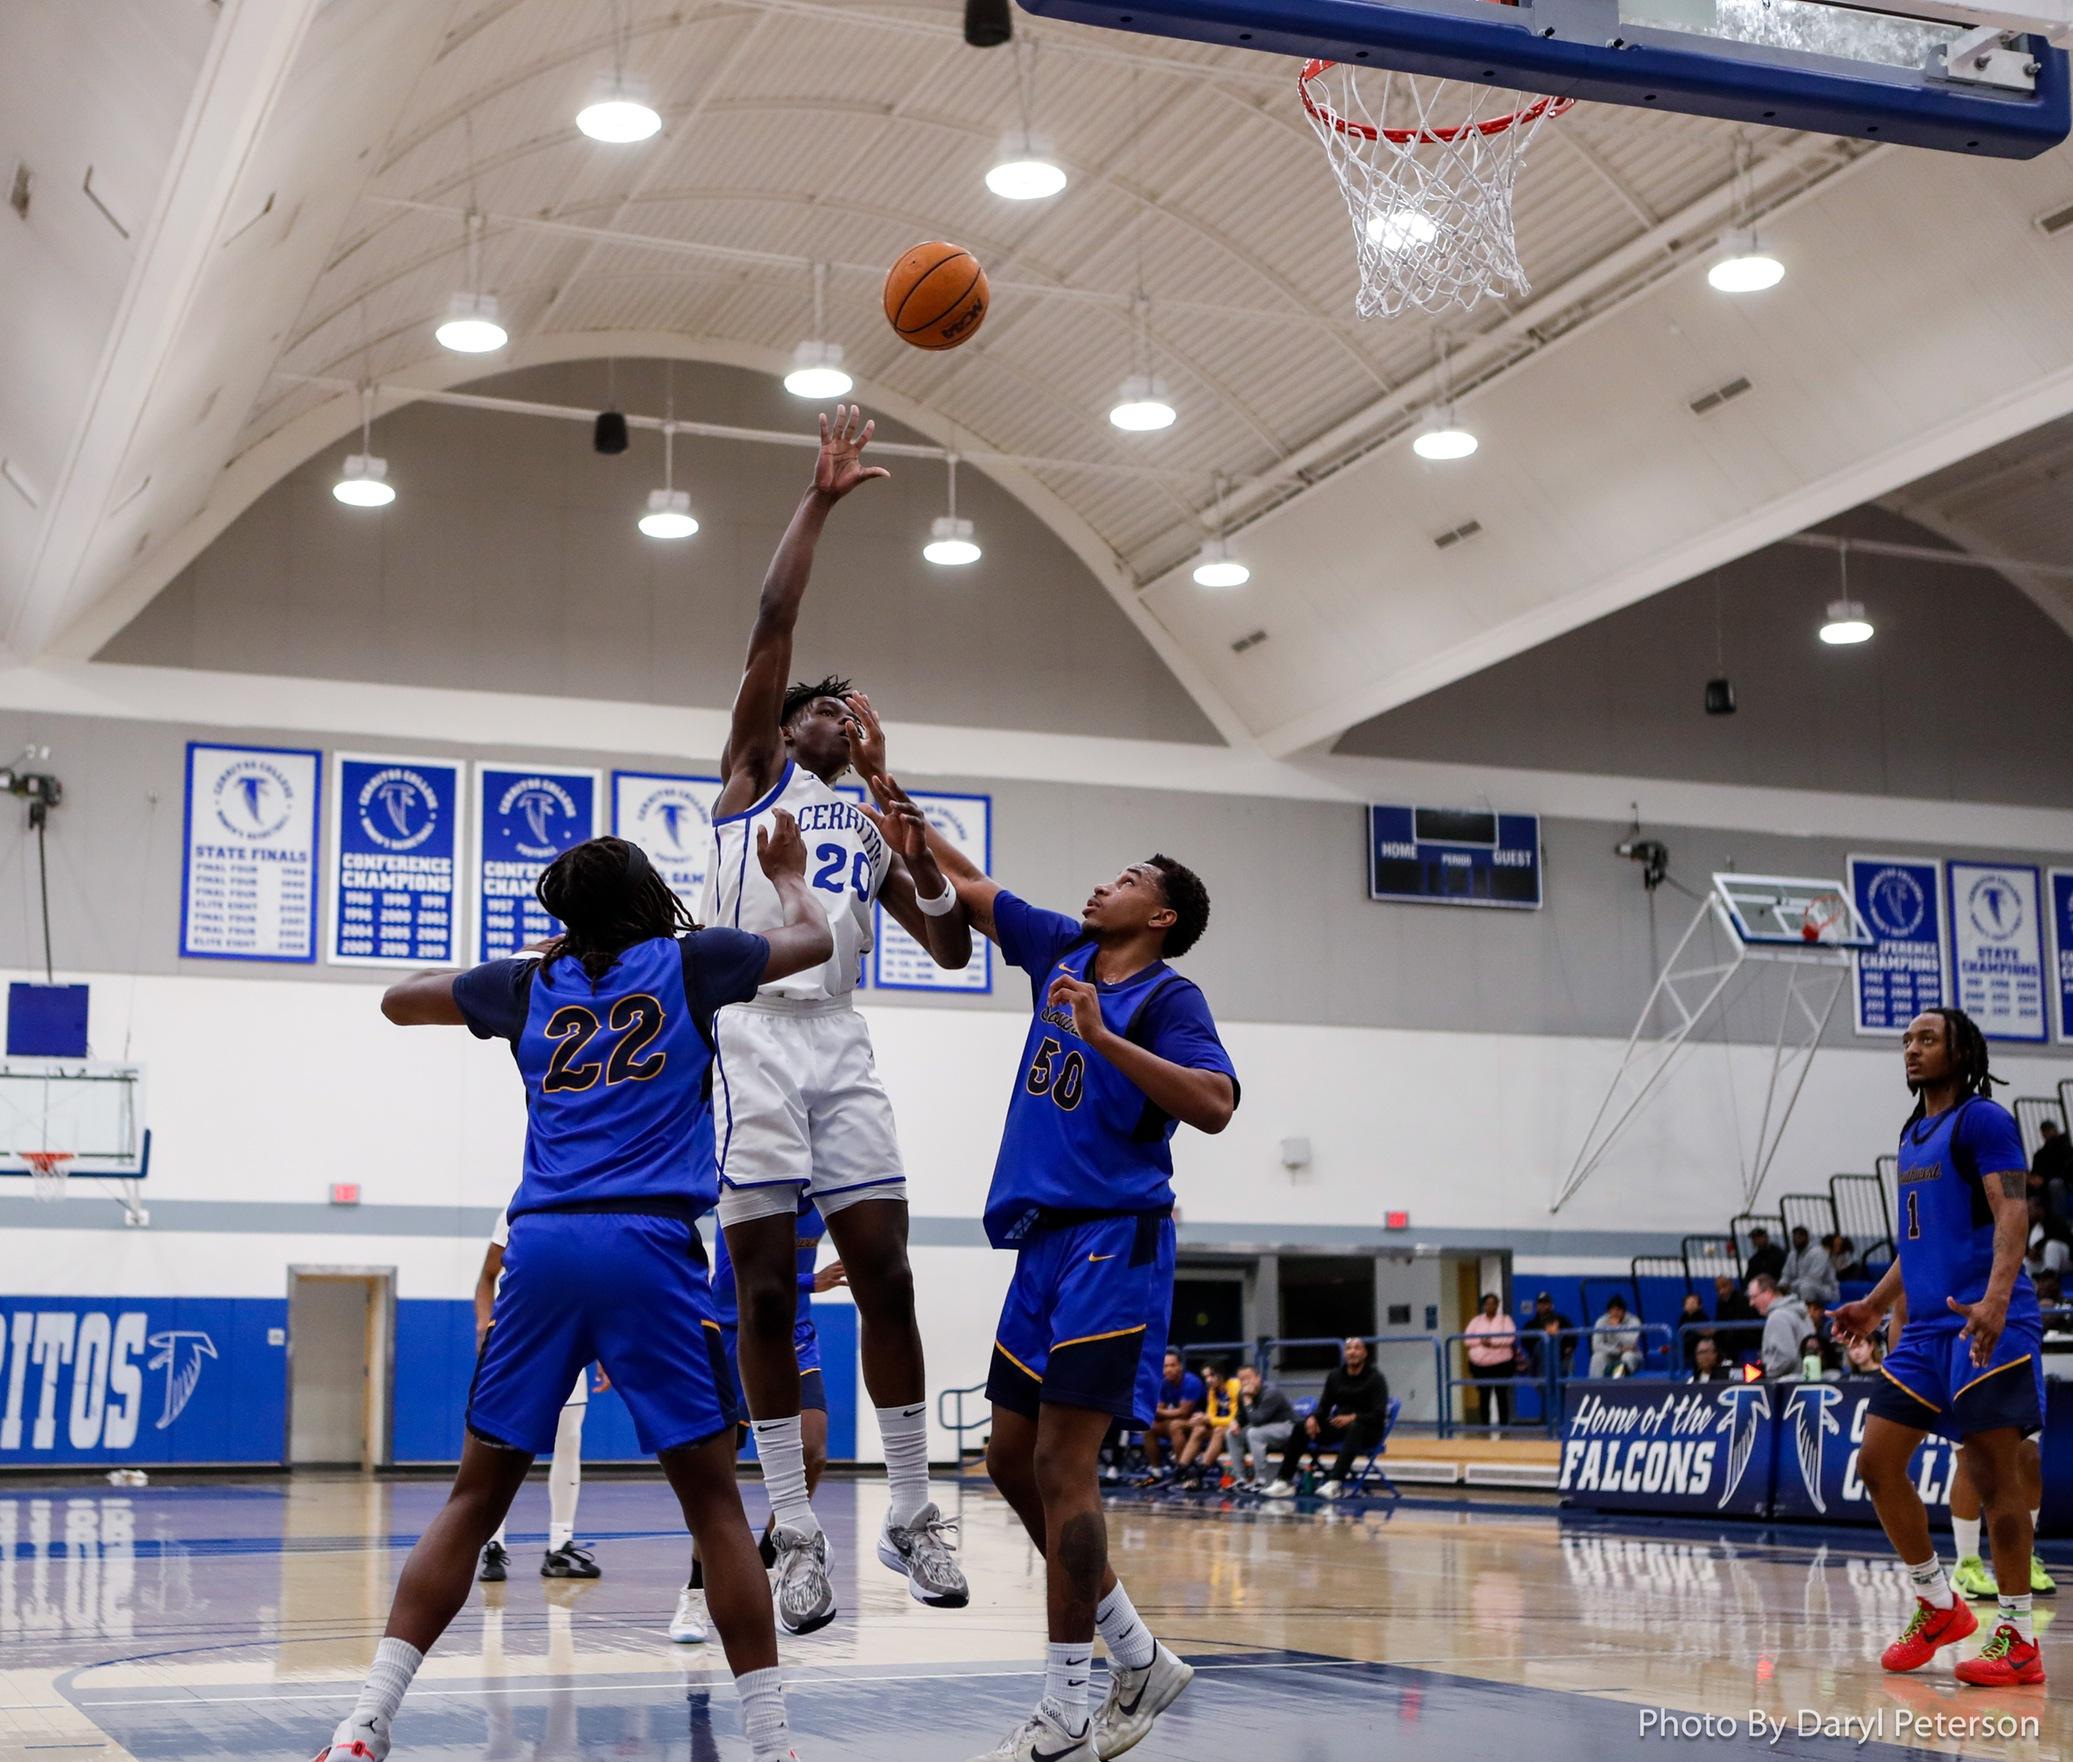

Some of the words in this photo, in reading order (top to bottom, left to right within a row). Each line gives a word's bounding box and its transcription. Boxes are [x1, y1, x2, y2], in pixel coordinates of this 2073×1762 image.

[195, 846, 246, 859] STATE
[251, 848, 307, 863] FINALS
[342, 852, 452, 873] CONFERENCE
[1381, 842, 1418, 860] HOME
[1492, 849, 1533, 867] GUEST
[341, 869, 452, 893] CHAMPIONS
[813, 843, 877, 903] 20
[1860, 952, 1939, 973] CHAMPIONS
[1977, 946, 2019, 960] STATE
[1962, 960, 2039, 976] CHAMPIONS
[542, 993, 667, 1093] 22
[1026, 1036, 1085, 1112] 50
[1907, 1190, 1921, 1241] 1
[0, 1311, 148, 1450] ITOS
[1570, 1393, 1642, 1437] Home
[1640, 1393, 1675, 1437] of
[1671, 1393, 1717, 1437] the
[1559, 1440, 1717, 1495] FALCONS
